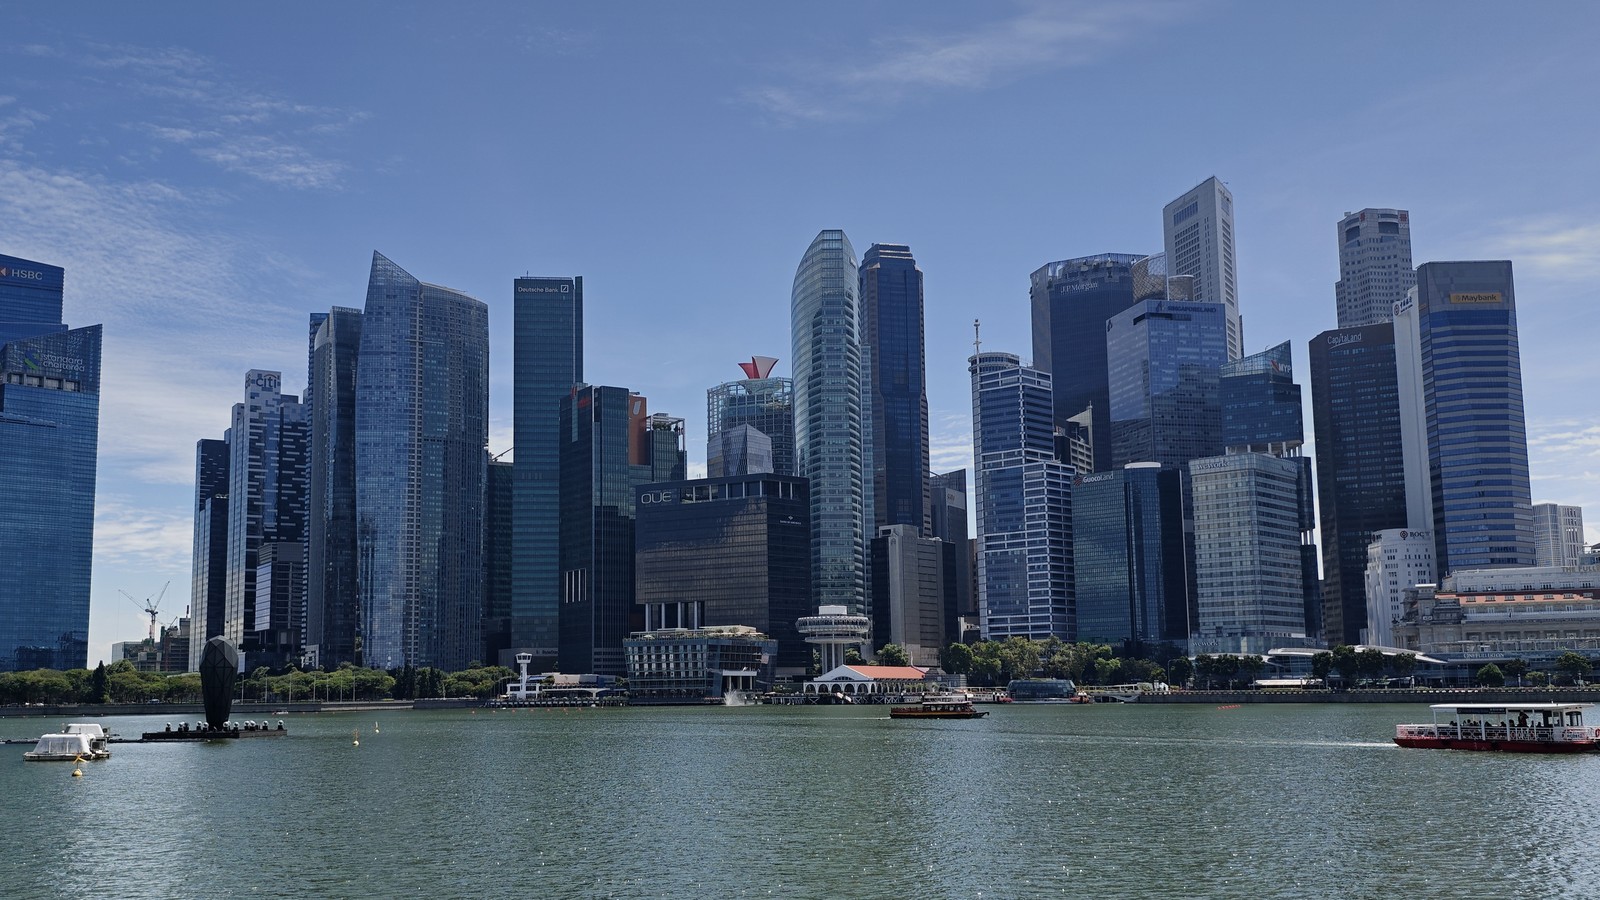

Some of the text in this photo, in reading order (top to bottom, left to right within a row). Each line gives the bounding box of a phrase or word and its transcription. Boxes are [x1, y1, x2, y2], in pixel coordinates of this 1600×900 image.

[11, 269, 43, 280] HSBC
[1461, 294, 1497, 302] Maybank
[42, 353, 83, 365] standard
[42, 361, 85, 372] chartered
[255, 376, 277, 389] citi
[641, 491, 672, 504] OUE
